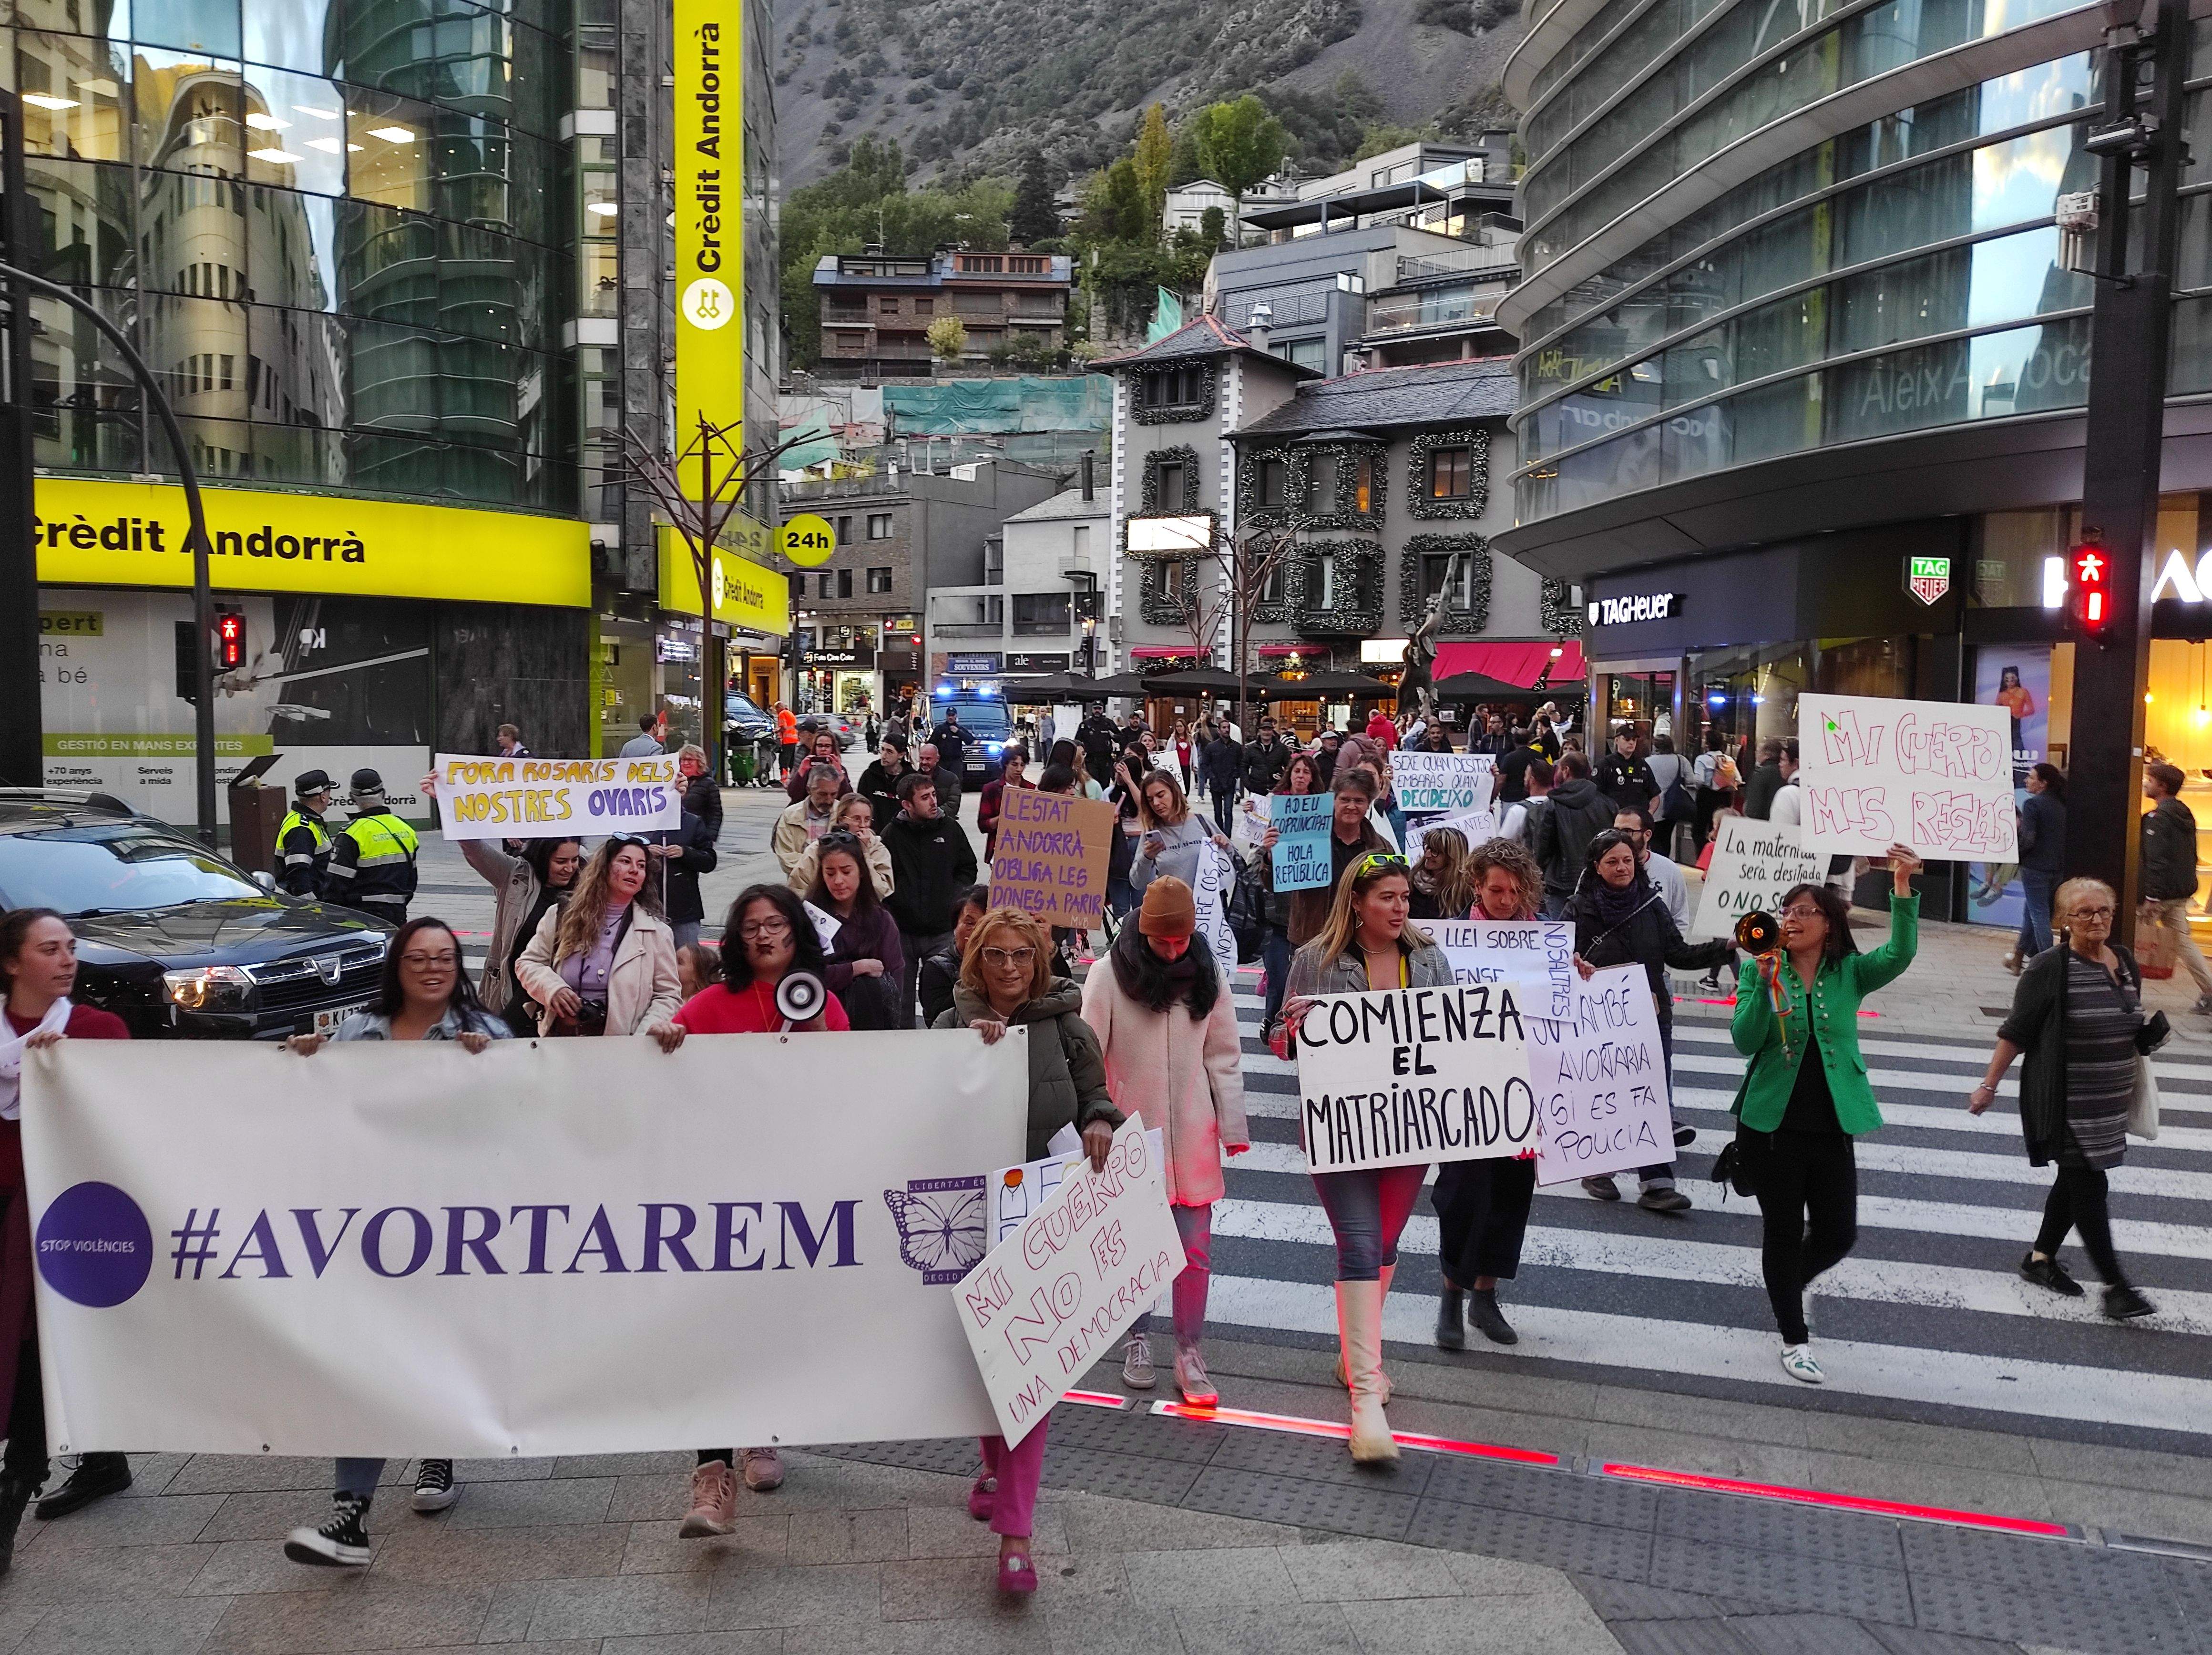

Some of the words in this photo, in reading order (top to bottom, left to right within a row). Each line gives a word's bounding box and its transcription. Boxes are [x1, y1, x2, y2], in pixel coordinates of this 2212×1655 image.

[694, 22, 720, 159] Andorrà
[695, 169, 721, 273] Crèdit
[787, 531, 829, 549] 24h
[1915, 561, 1946, 575] TAG
[1914, 579, 1946, 599] HEUER
[58, 666, 87, 683] bé
[57, 738, 107, 750] GESTIÓ
[111, 741, 129, 750] EN
[133, 741, 172, 751] MANS
[1821, 710, 1884, 766] MI
[1896, 713, 2002, 780] CUERPO
[137, 766, 173, 775] Serveis
[446, 761, 514, 784] FORA
[523, 760, 618, 783] ROSARIS
[627, 760, 674, 783] DELS
[1394, 756, 1418, 771] SEXE
[1423, 756, 1451, 774] QUAN
[1454, 756, 1491, 773] DESITJO
[1397, 771, 1444, 788] EMBARÀS
[1452, 775, 1479, 789] QUAN
[384, 794, 416, 805] dorrà
[453, 788, 572, 823] NOSTRES
[587, 786, 667, 816] OVARIS
[1005, 793, 1073, 823] L'ESTAT
[1285, 797, 1320, 814] ADEU
[1402, 789, 1473, 807] DECIDEIXO
[1273, 813, 1333, 834] COPRINCIPAT
[1810, 787, 1894, 841] MIS
[1912, 790, 2015, 853] REGLAS
[1288, 844, 1312, 862] HOLA
[1726, 828, 1746, 855] La
[995, 858, 1052, 884] OBLIGA
[1058, 865, 1087, 888] LES
[1276, 861, 1328, 885] REPÚBLICA
[1740, 859, 1767, 881] serà
[992, 885, 1045, 911] DONES
[1046, 893, 1057, 911] A
[1064, 893, 1101, 915] PARIR
[1718, 890, 1730, 908] O
[1733, 890, 1762, 912] NO
[1446, 925, 1477, 948] LLEI
[1487, 930, 1540, 950] SOBRE
[1544, 923, 1571, 1018] NOSALTRES
[1298, 986, 1525, 1047] COMIENZA
[1392, 1043, 1437, 1076] EL
[1558, 1039, 1651, 1085] AVORTARIA
[1551, 1090, 1575, 1125] SI
[1591, 1092, 1617, 1120] ES
[1630, 1086, 1656, 1107] FA
[1306, 1077, 1535, 1166] MATRIARCADO
[909, 1180, 966, 1191] LLIBERTAT
[974, 1178, 985, 1186] ÉS
[171, 1199, 863, 1280] #AVORTAREM
[965, 1265, 1014, 1328] MI
[1023, 1131, 1146, 1270] CUERPO
[41, 1239, 71, 1252] STOP
[72, 1238, 134, 1253] VIOLÈNCIES
[924, 1271, 968, 1282] DECIDI
[1005, 1272, 1082, 1366] NO
[1090, 1219, 1126, 1281] ES
[1009, 1374, 1053, 1424] UNA
[1058, 1251, 1170, 1374] DEMOCRACIA
